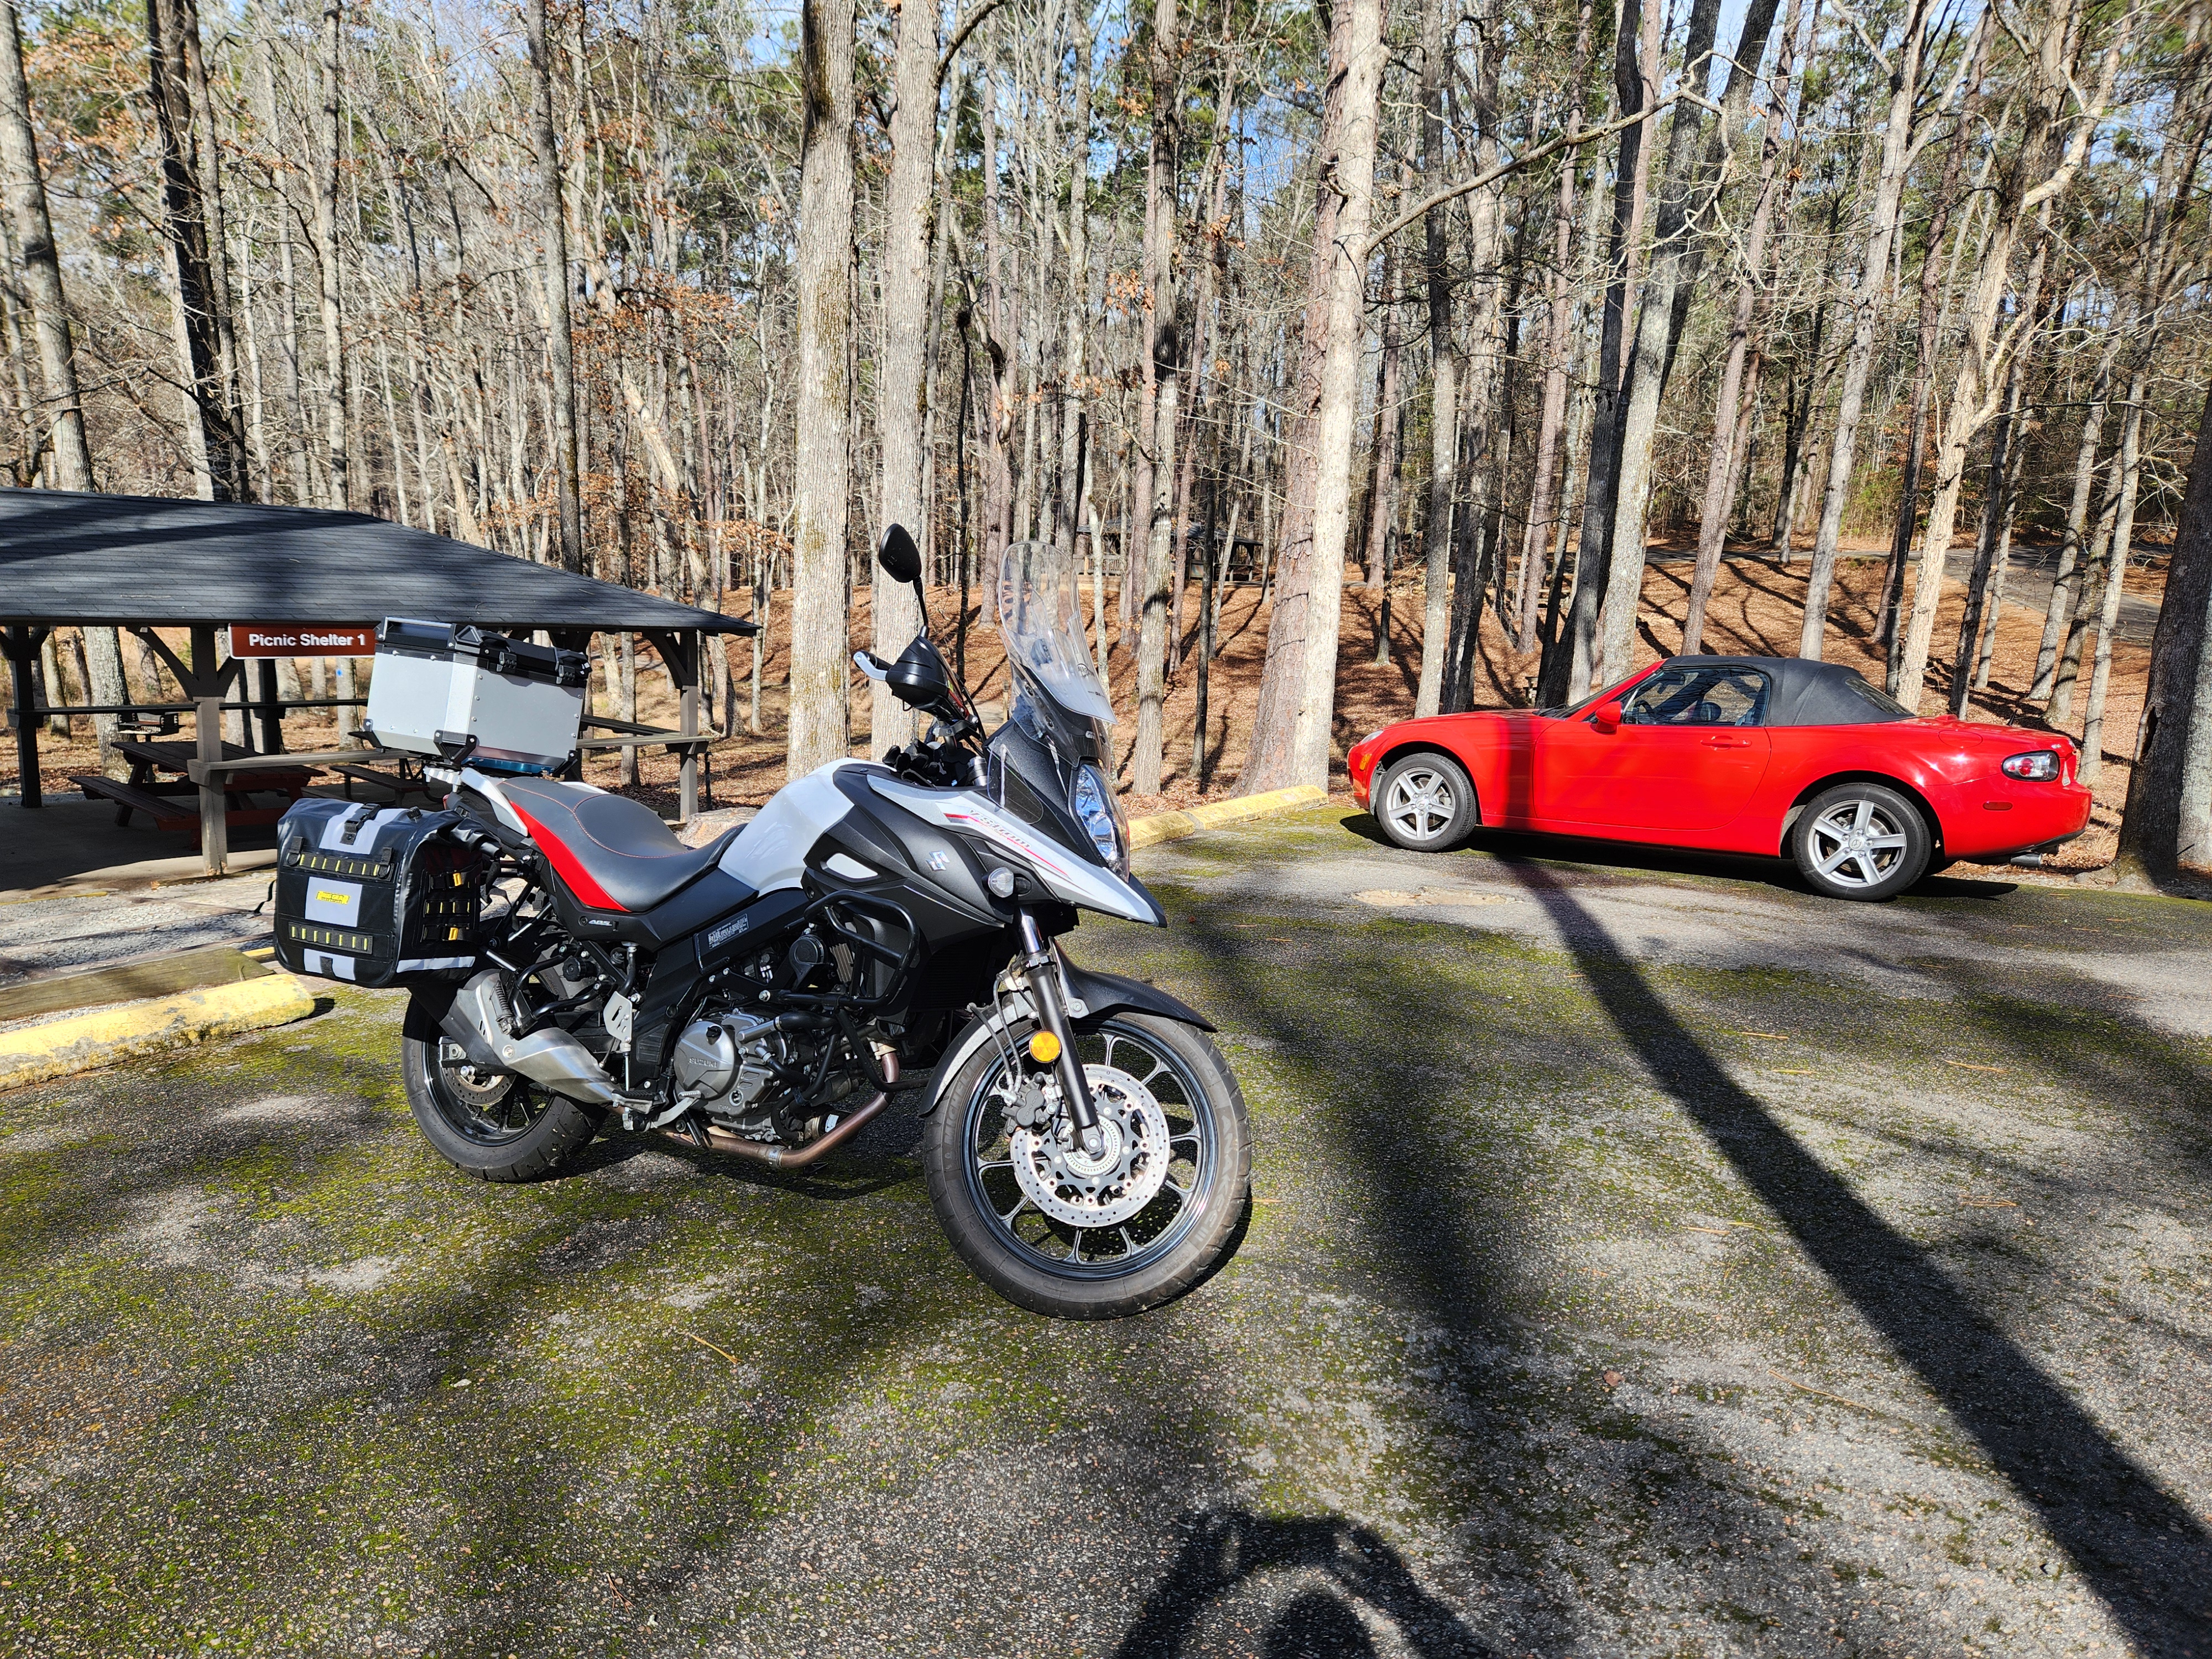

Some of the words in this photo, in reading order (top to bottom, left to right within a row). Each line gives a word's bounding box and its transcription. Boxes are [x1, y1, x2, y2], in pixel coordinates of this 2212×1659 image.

[249, 634, 297, 646] Picnic
[300, 634, 354, 646] Shelter
[357, 634, 366, 645] 1
[689, 1057, 717, 1068] SUZUKI
[942, 1053, 984, 1146] MICHELIN
[1022, 1094, 1039, 1121] TOKICO
[1203, 1114, 1233, 1228] ANAKEE
